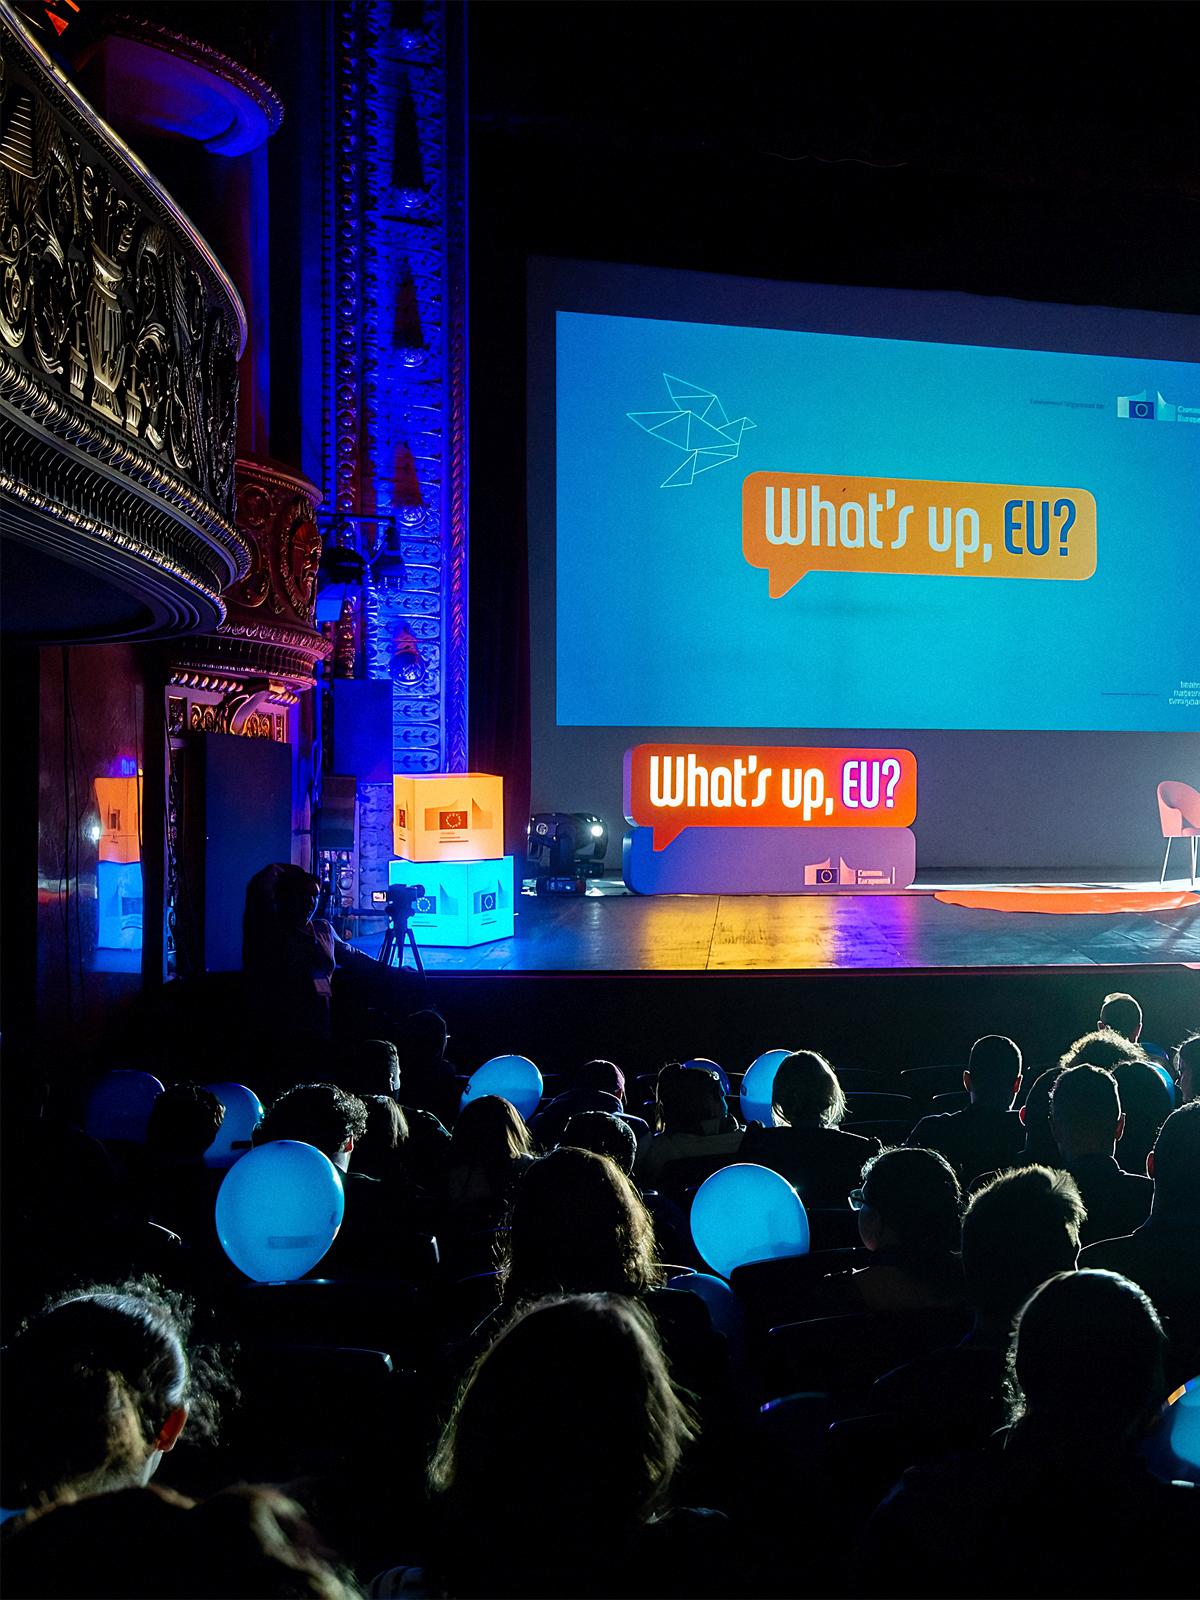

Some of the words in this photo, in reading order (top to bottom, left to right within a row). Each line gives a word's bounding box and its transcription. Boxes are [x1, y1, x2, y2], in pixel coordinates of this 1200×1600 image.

[765, 485, 914, 549] What's
[928, 506, 992, 568] up,
[1004, 498, 1077, 557] EU?
[650, 753, 772, 808] What's
[781, 767, 834, 821] up,
[843, 758, 901, 808] EU?
